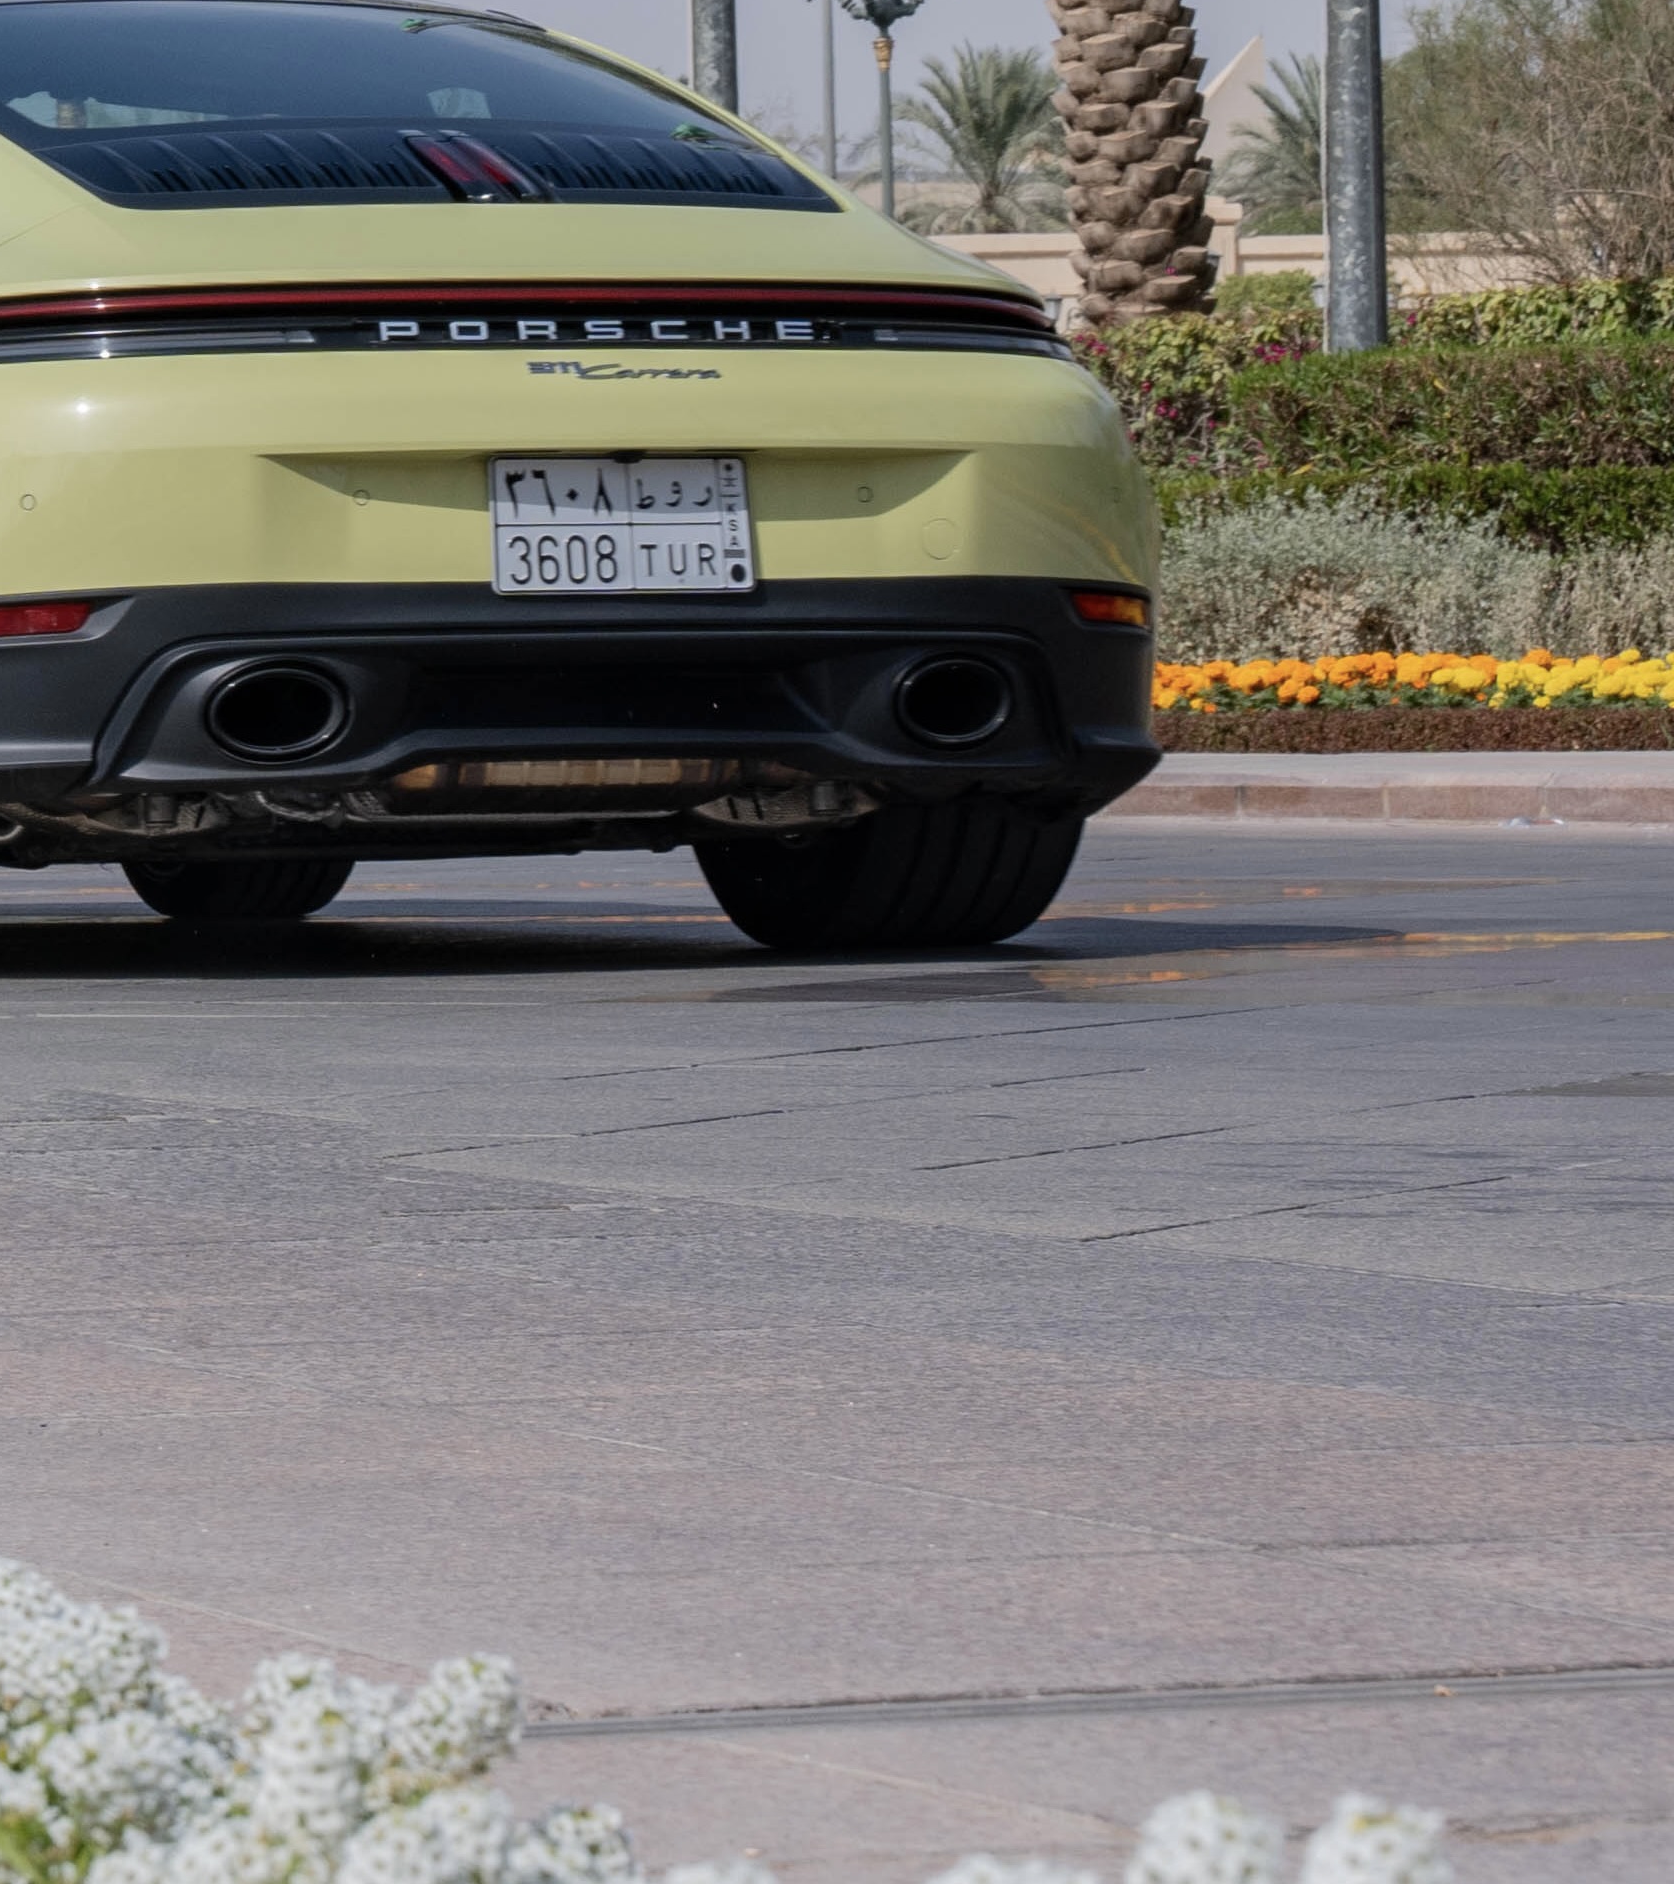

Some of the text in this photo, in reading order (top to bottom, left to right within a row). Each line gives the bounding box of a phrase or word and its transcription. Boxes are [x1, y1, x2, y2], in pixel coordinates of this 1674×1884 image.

[379, 320, 815, 341] PORSCHE
[576, 362, 722, 380] Carrera
[507, 534, 717, 585] 3608 TUR
